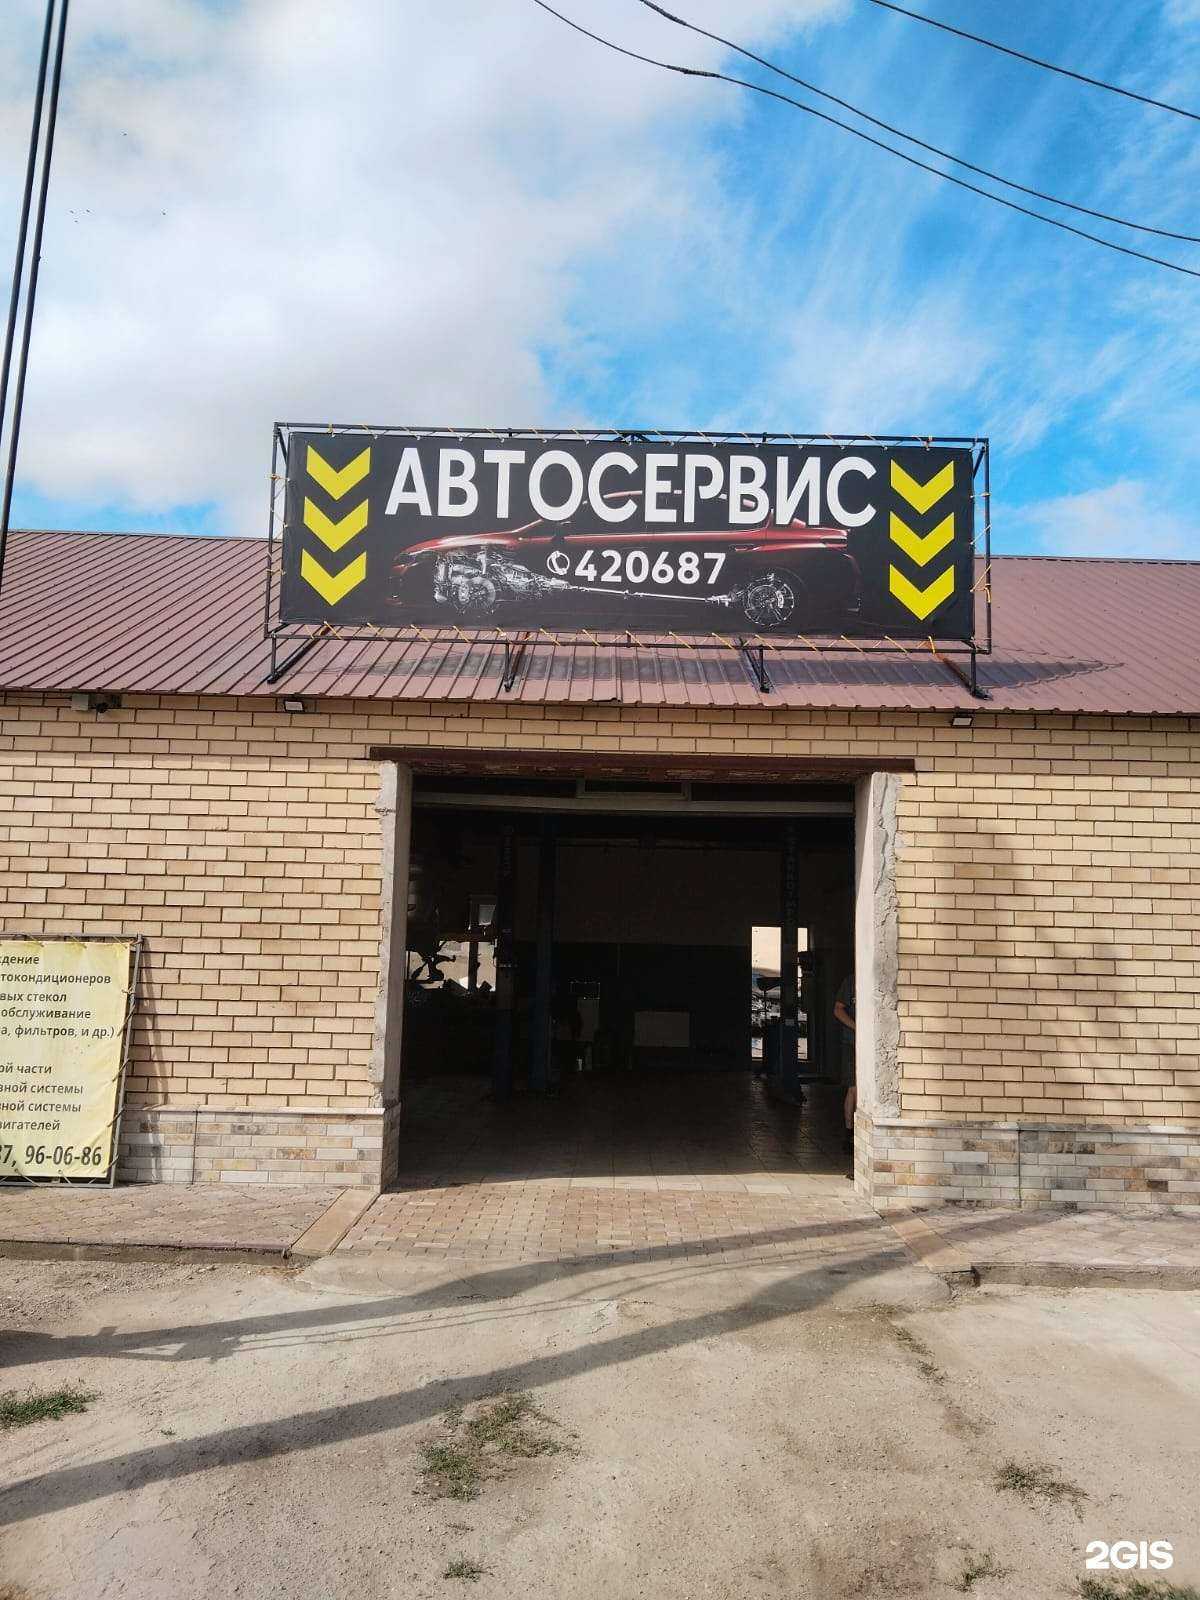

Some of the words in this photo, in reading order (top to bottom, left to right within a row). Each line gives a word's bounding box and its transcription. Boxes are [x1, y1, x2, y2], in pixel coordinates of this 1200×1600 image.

[384, 447, 877, 528] АВТОСЕРВИС
[574, 549, 726, 585] 420687
[0, 955, 40, 966] дение
[27, 992, 67, 1003] стекол
[1, 1007, 91, 1021] обслуживание
[81, 1028, 89, 1036] и
[92, 1027, 115, 1039] др.)
[16, 1064, 52, 1074] части
[30, 1084, 83, 1094] системы
[28, 1102, 81, 1112] системы
[0, 1145, 17, 1168] 7,
[24, 1145, 102, 1166] 96-06-86
